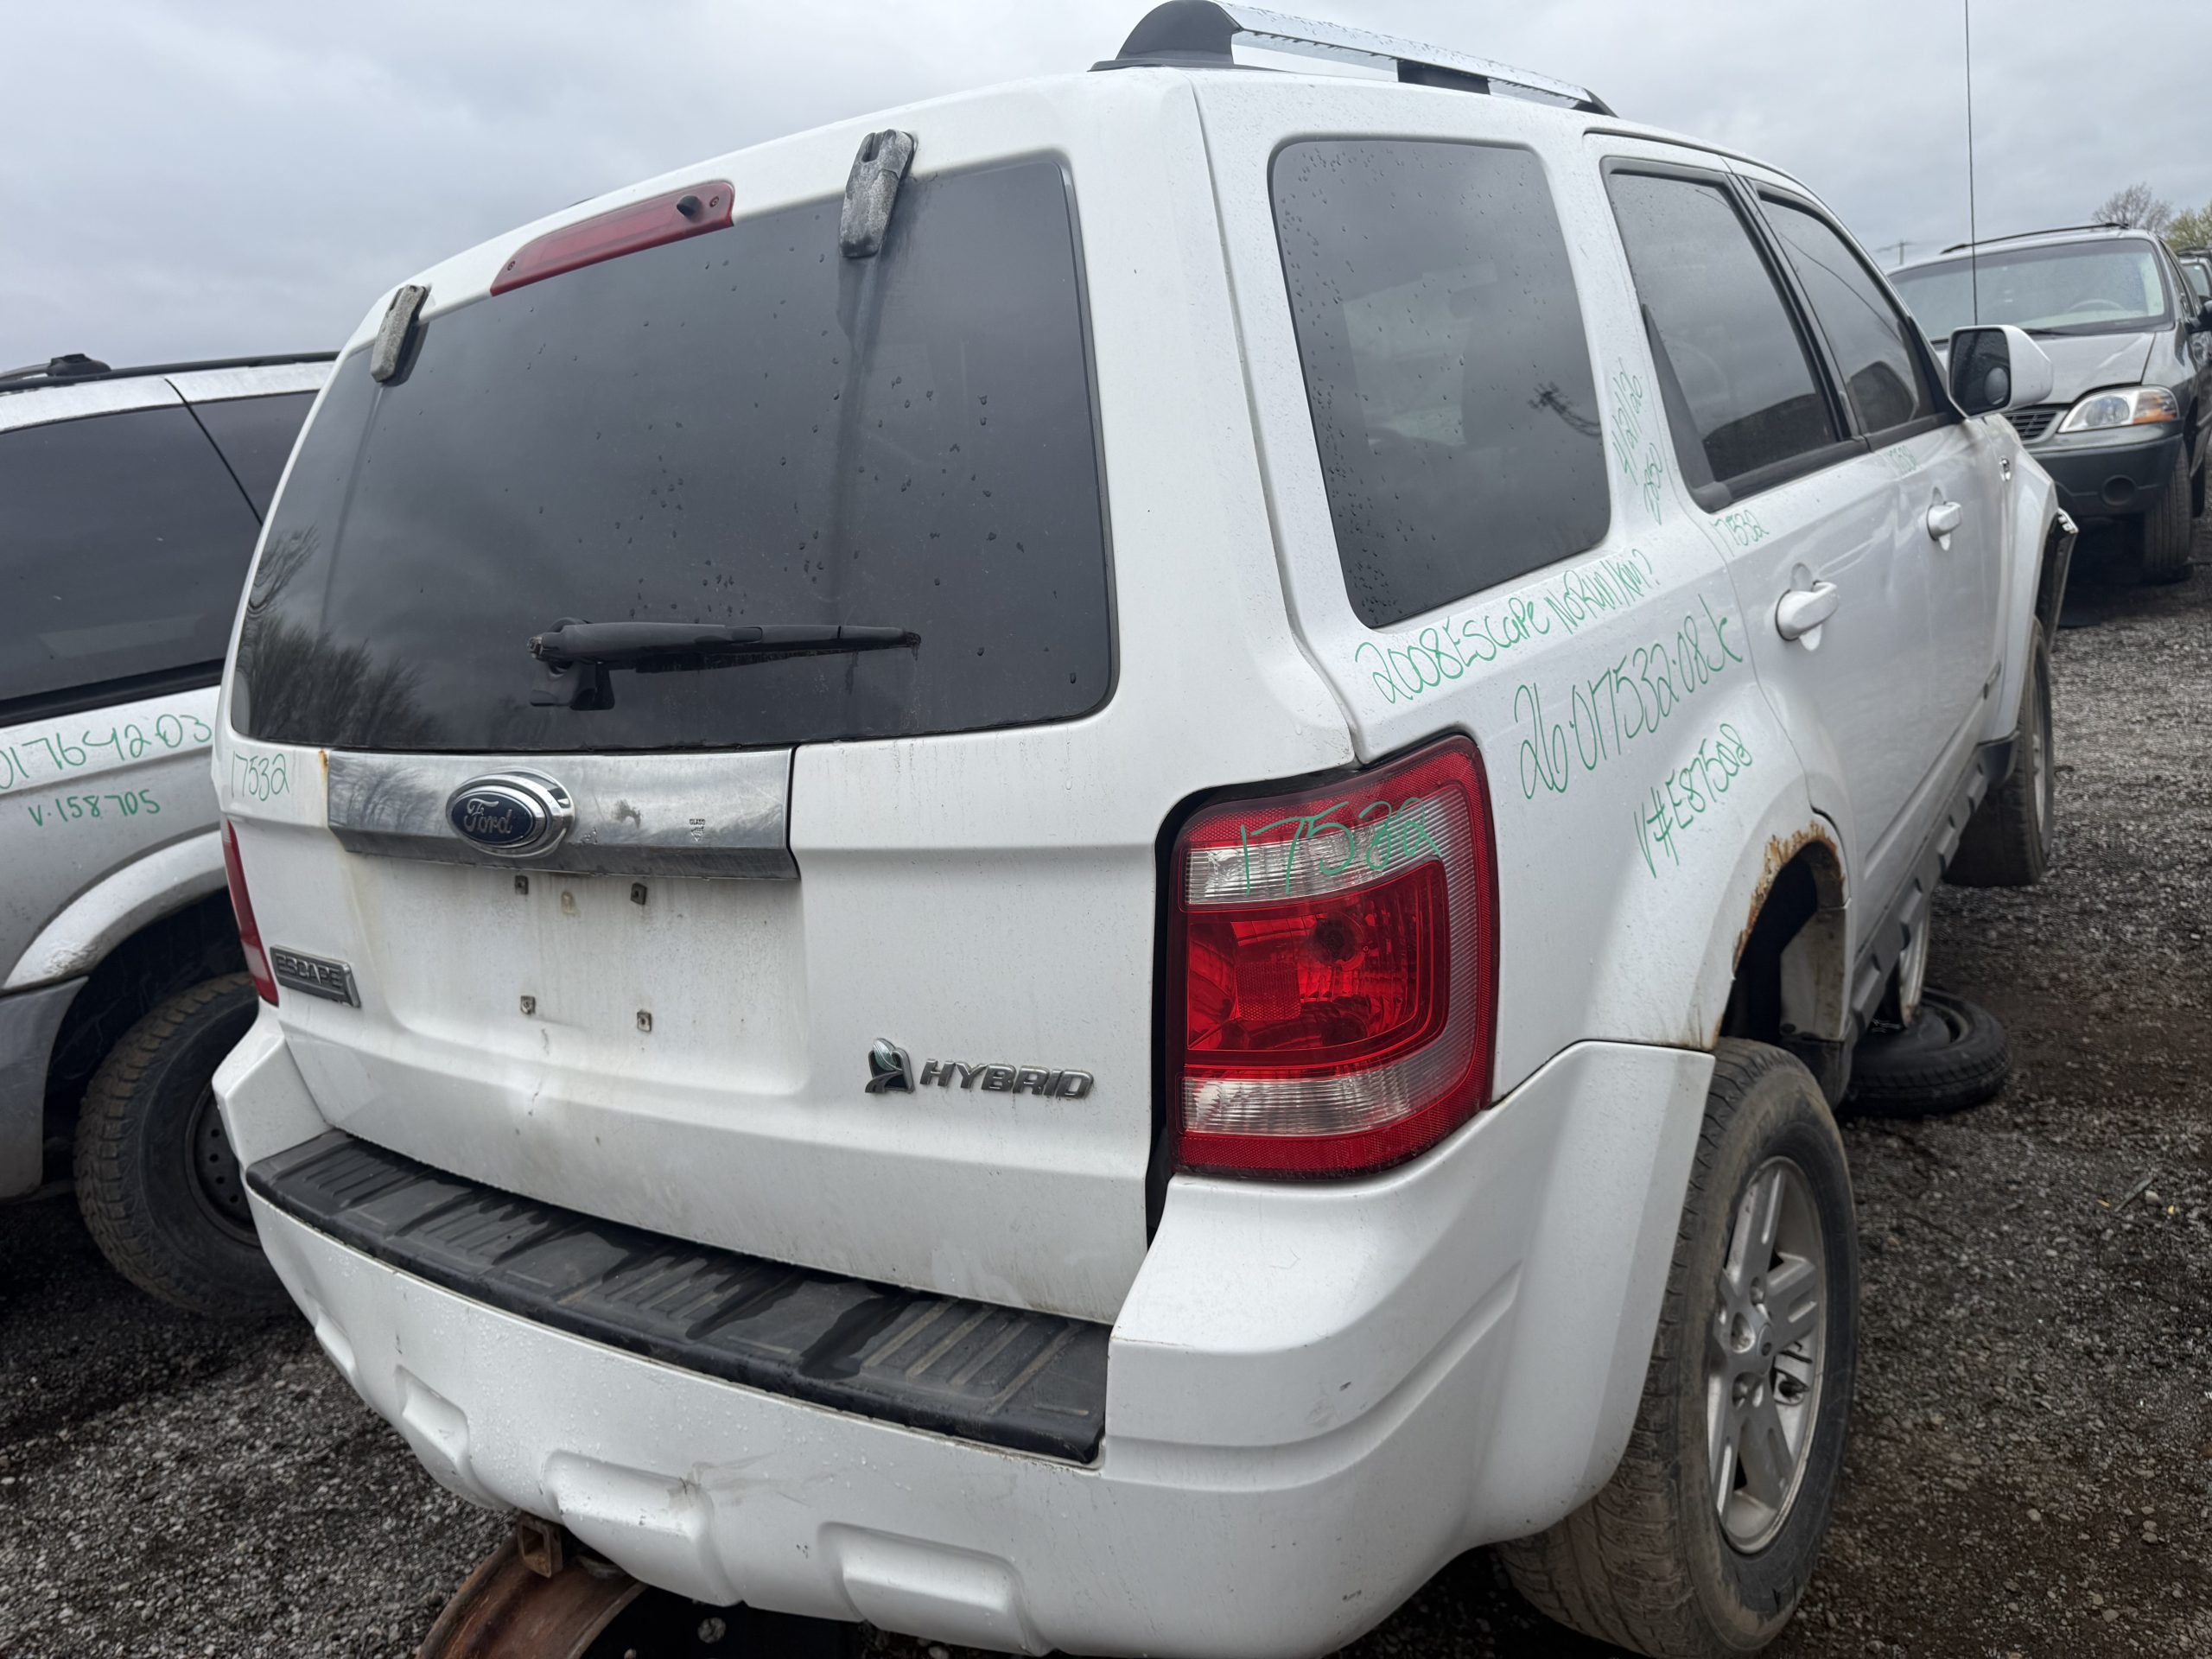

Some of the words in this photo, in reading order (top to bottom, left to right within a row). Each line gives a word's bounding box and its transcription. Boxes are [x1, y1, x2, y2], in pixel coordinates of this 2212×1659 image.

[1709, 510, 1770, 557] 17532
[1355, 639, 1464, 703] 2008
[231, 751, 290, 802] 17532
[463, 798, 513, 834] Ford
[1241, 797, 1441, 896] 17532
[274, 951, 345, 989] ESCAPE
[919, 1058, 1095, 1100] HYBRID
